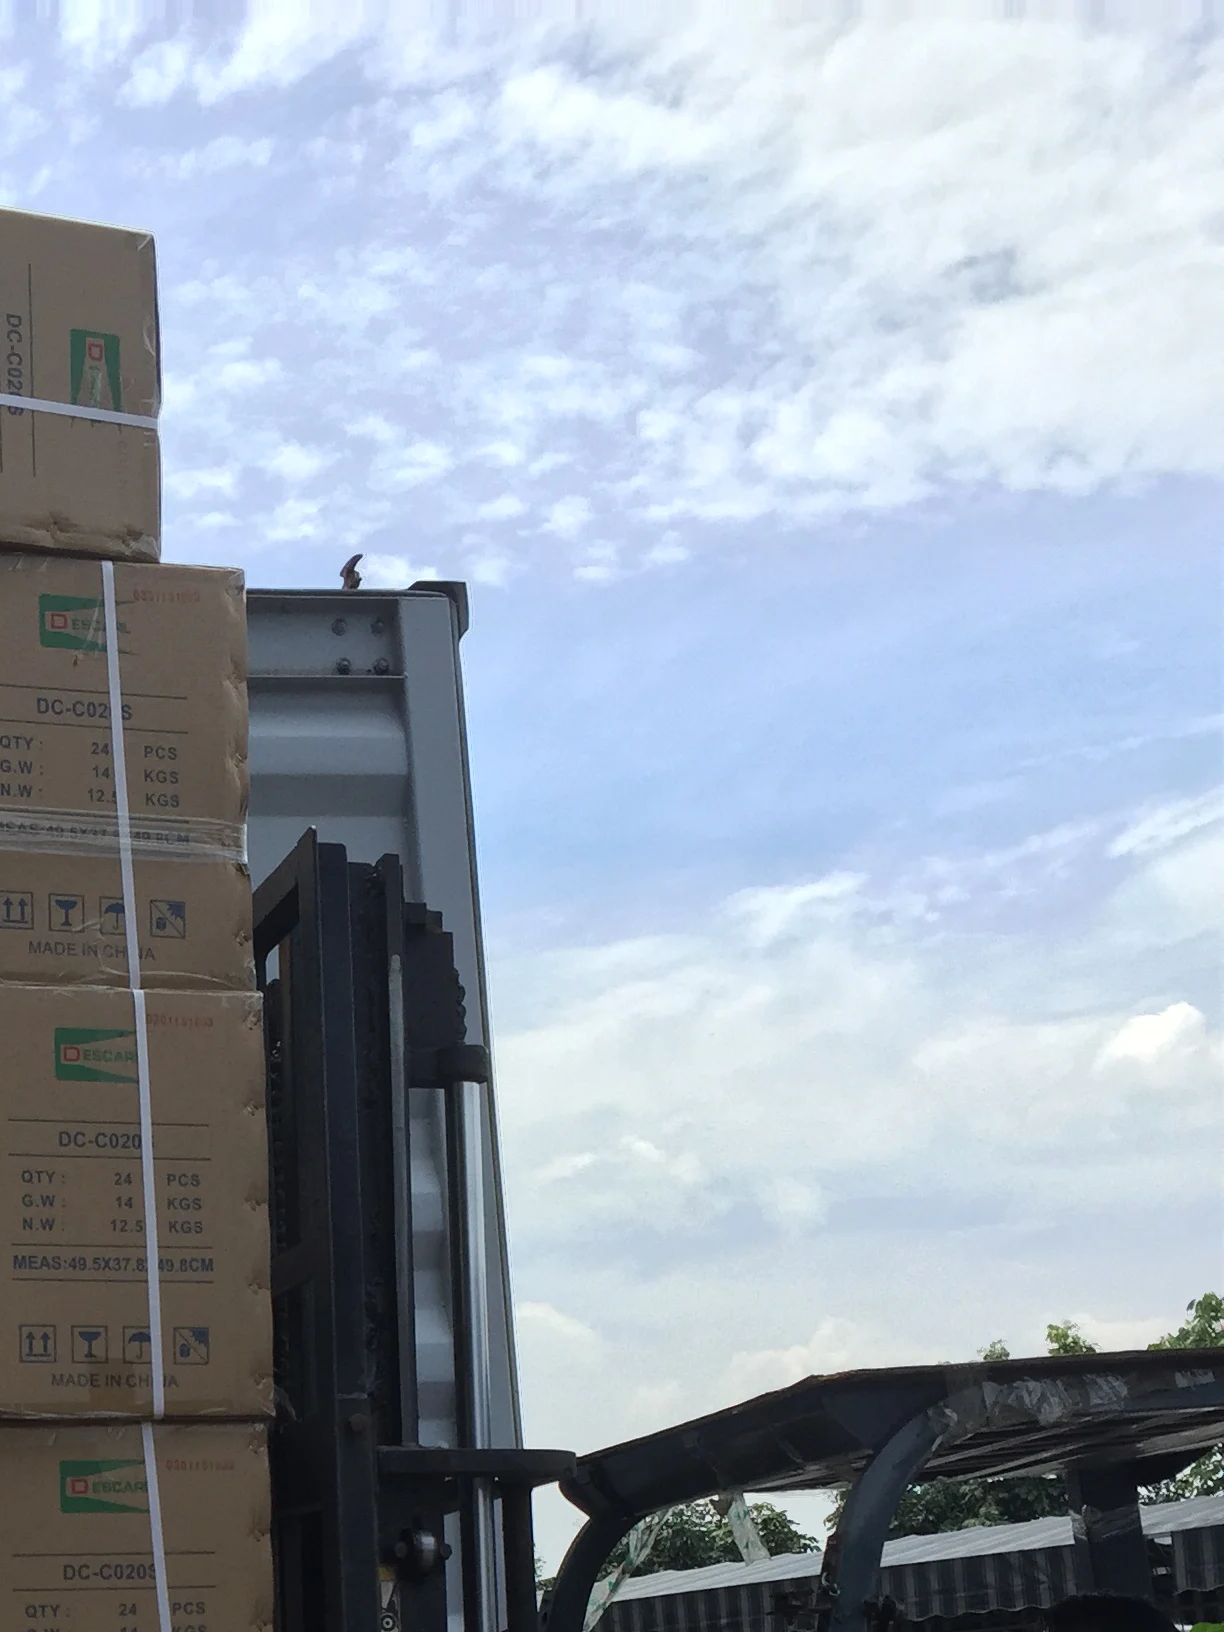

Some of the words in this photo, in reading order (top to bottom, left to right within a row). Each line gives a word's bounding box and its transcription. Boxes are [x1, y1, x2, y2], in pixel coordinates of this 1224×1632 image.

[36, 697, 133, 721] DC-C02S
[91, 742, 109, 756] 24
[144, 746, 177, 760] PCS
[92, 766, 109, 779] 14
[144, 770, 179, 784] KGS
[145, 793, 179, 807] KGS
[29, 940, 76, 956] MADE
[82, 943, 98, 956] IN
[59, 1130, 143, 1150] DC-C020
[114, 1172, 132, 1186] 24
[167, 1173, 200, 1187] PCS
[115, 1196, 133, 1209] 14
[167, 1197, 202, 1211] KGS
[110, 1219, 143, 1233] 12.5
[169, 1220, 203, 1234] KGS
[51, 1373, 100, 1388] MADE
[105, 1374, 122, 1388] IN
[119, 1603, 137, 1617] 24
[172, 1602, 206, 1615] PCS
